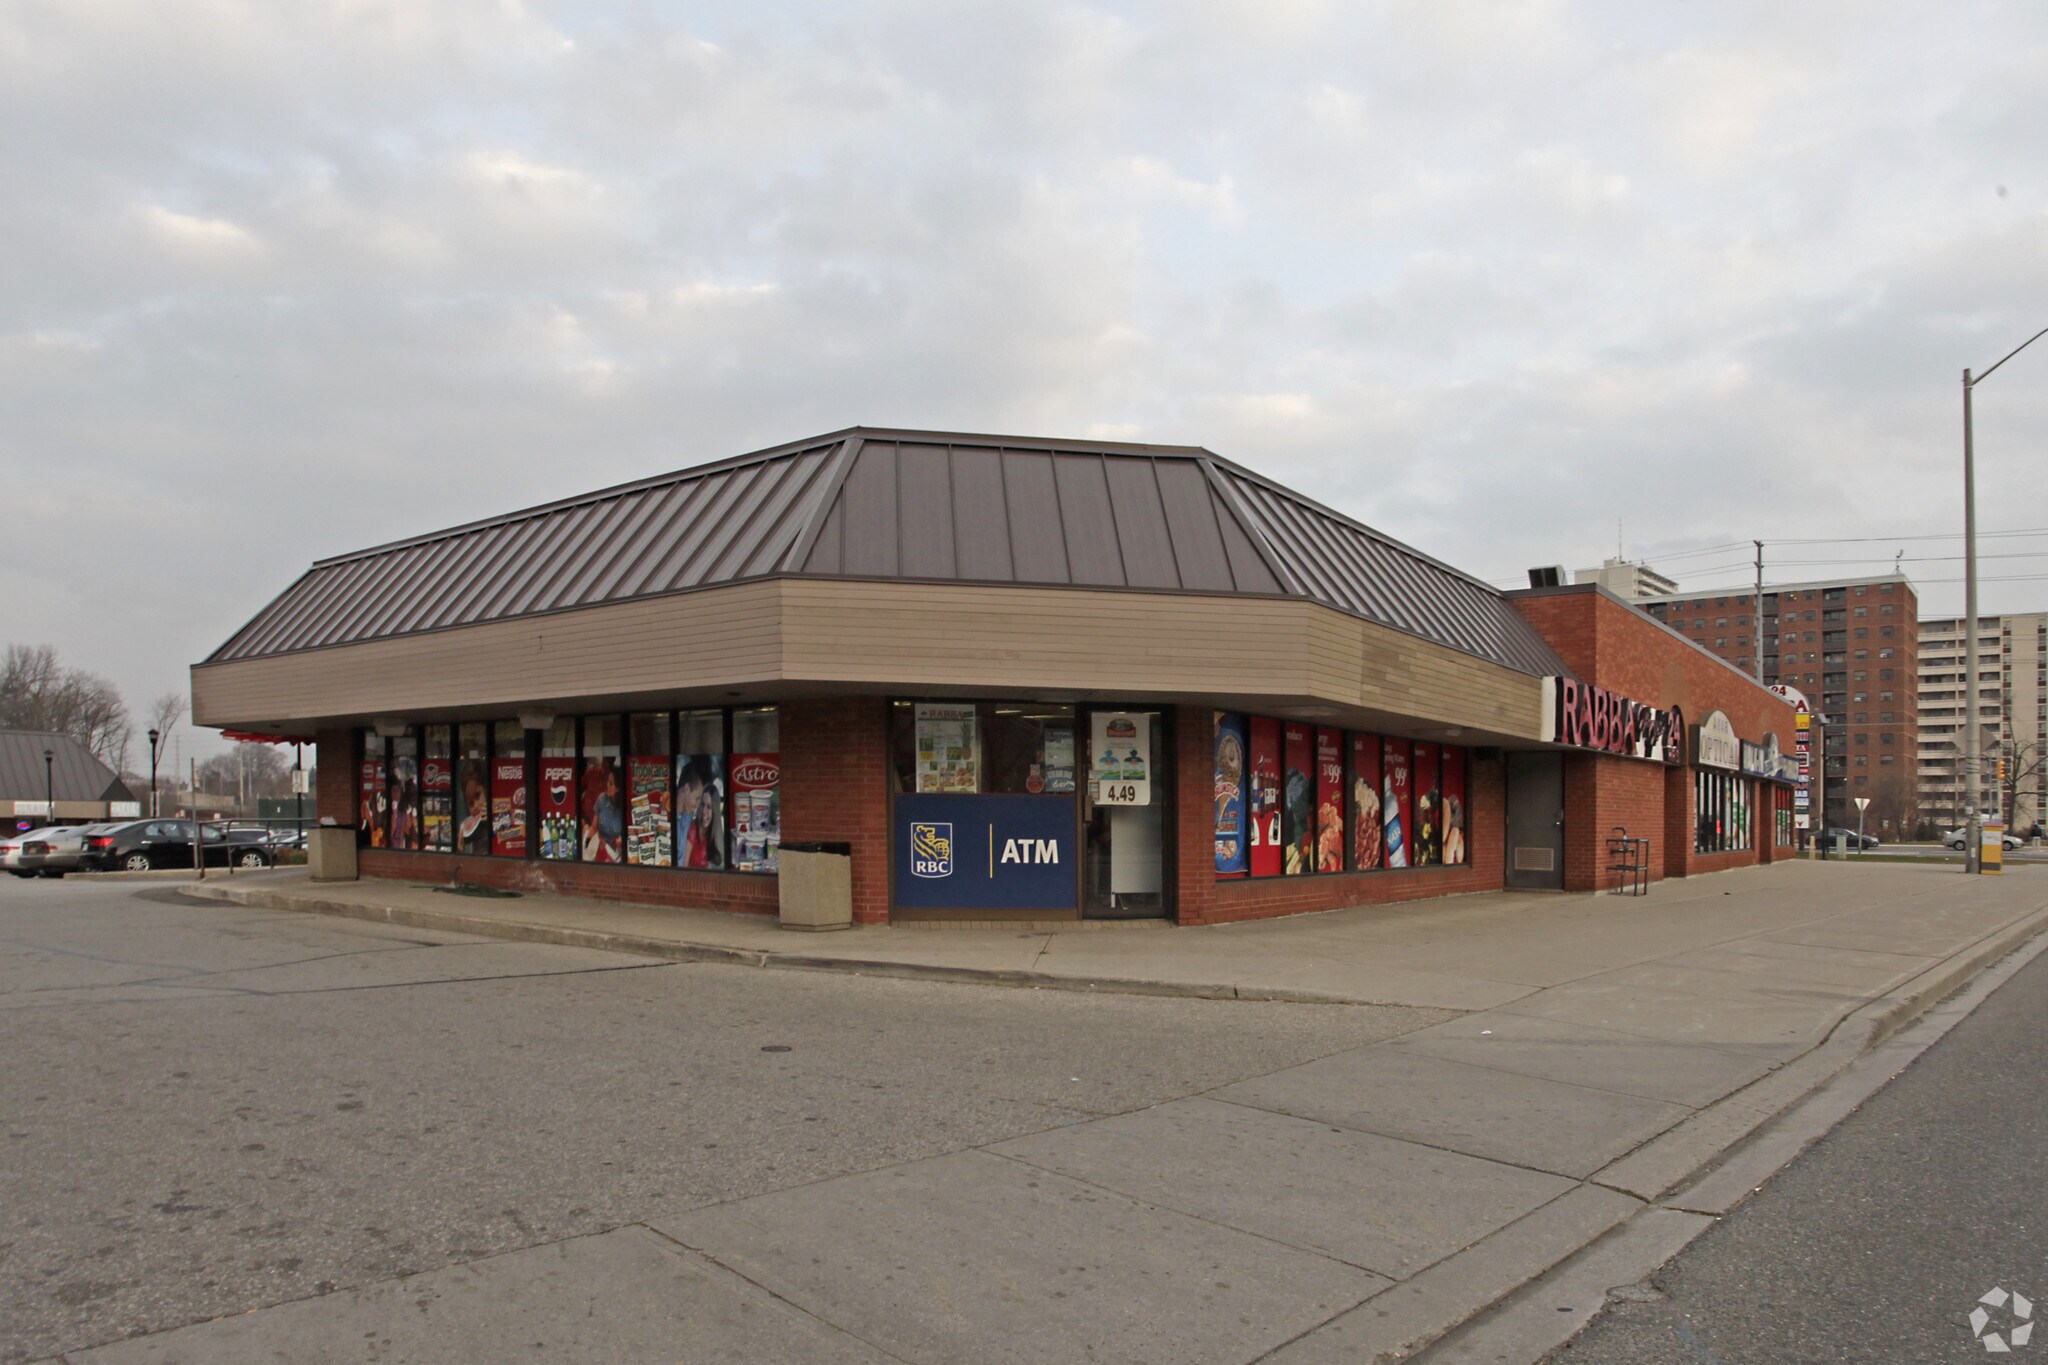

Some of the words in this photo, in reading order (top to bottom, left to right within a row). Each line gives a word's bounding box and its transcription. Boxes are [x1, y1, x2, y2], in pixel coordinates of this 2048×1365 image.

[1560, 676, 1638, 756] RABBA
[1667, 712, 1681, 747] 24
[1701, 735, 1738, 766] OPTICAL
[497, 765, 523, 780] Nestlé
[545, 767, 573, 781] PEPSI
[736, 766, 780, 782] Astro
[1107, 785, 1136, 802] 4.49
[1000, 838, 1059, 864] ATM
[916, 860, 949, 873] RBC
